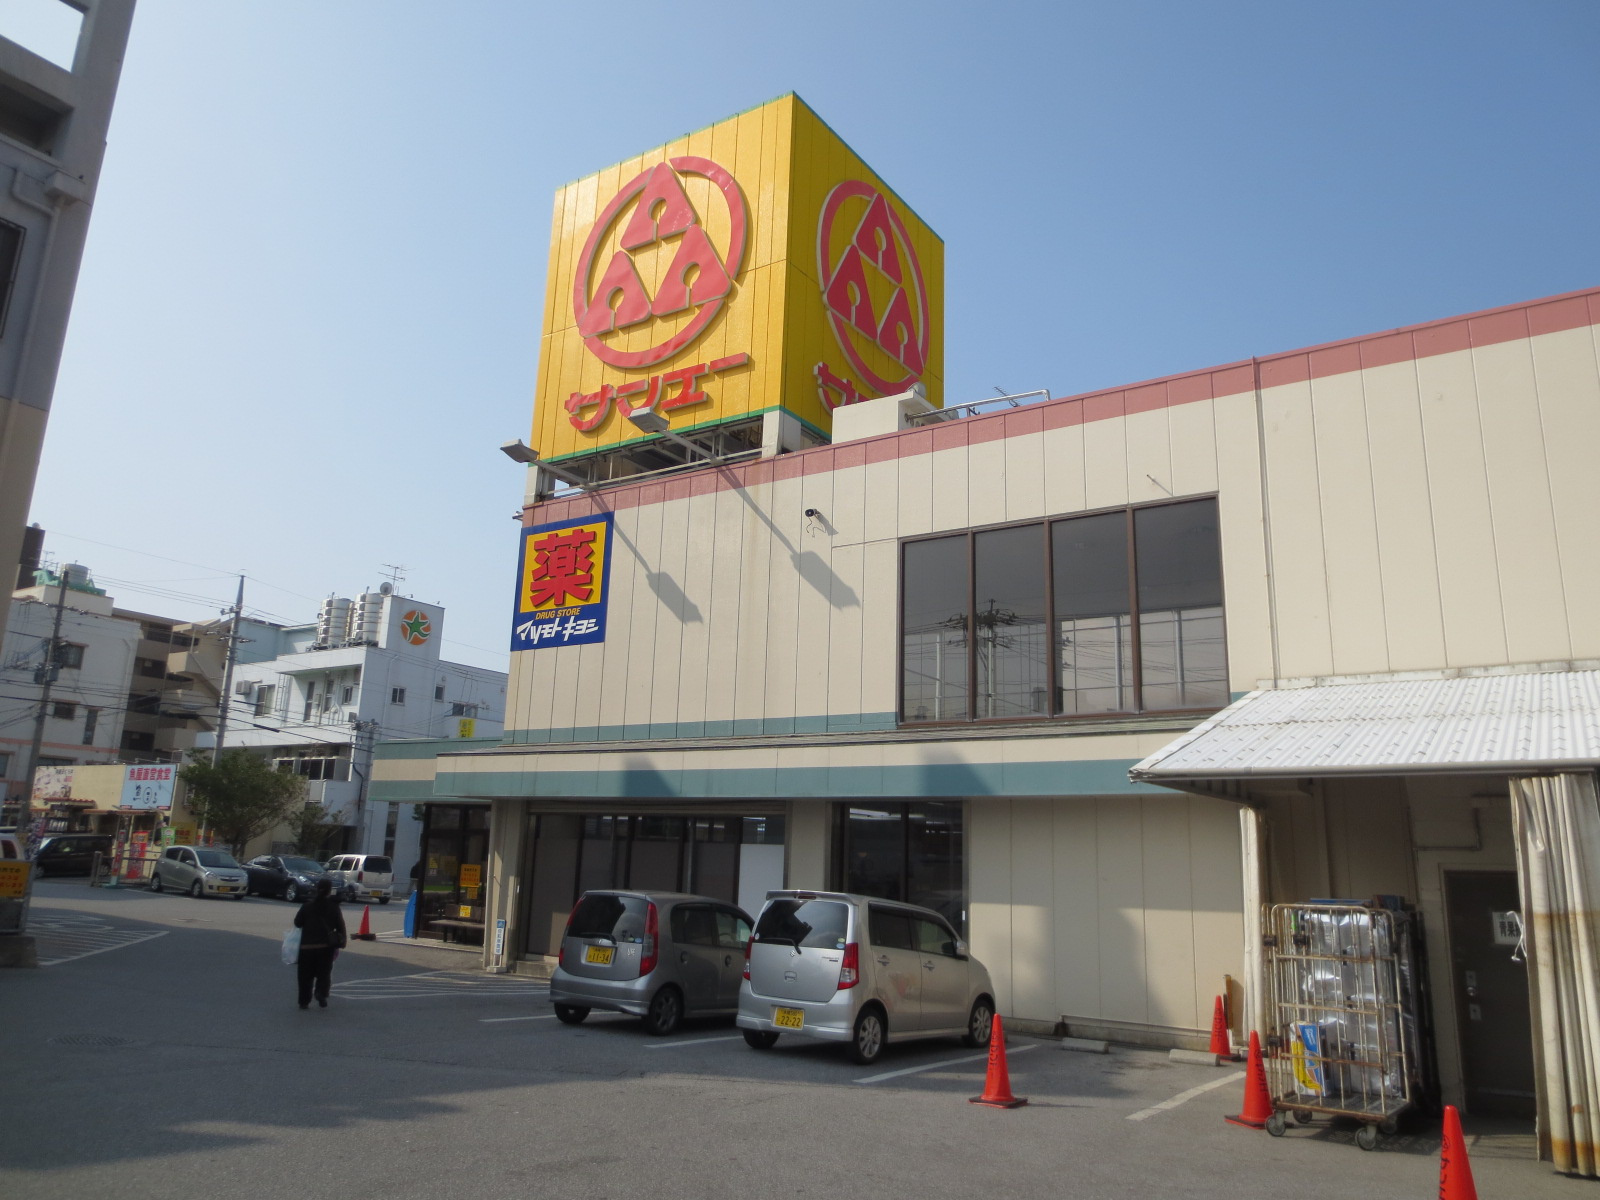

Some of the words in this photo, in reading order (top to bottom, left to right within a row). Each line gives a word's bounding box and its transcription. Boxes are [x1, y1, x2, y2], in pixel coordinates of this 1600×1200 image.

[564, 352, 750, 432] サンエー
[530, 528, 596, 607] 薬
[516, 615, 600, 645] マツモトキヨシ
[535, 609, 556, 620] DRUG
[556, 607, 581, 618] STORE
